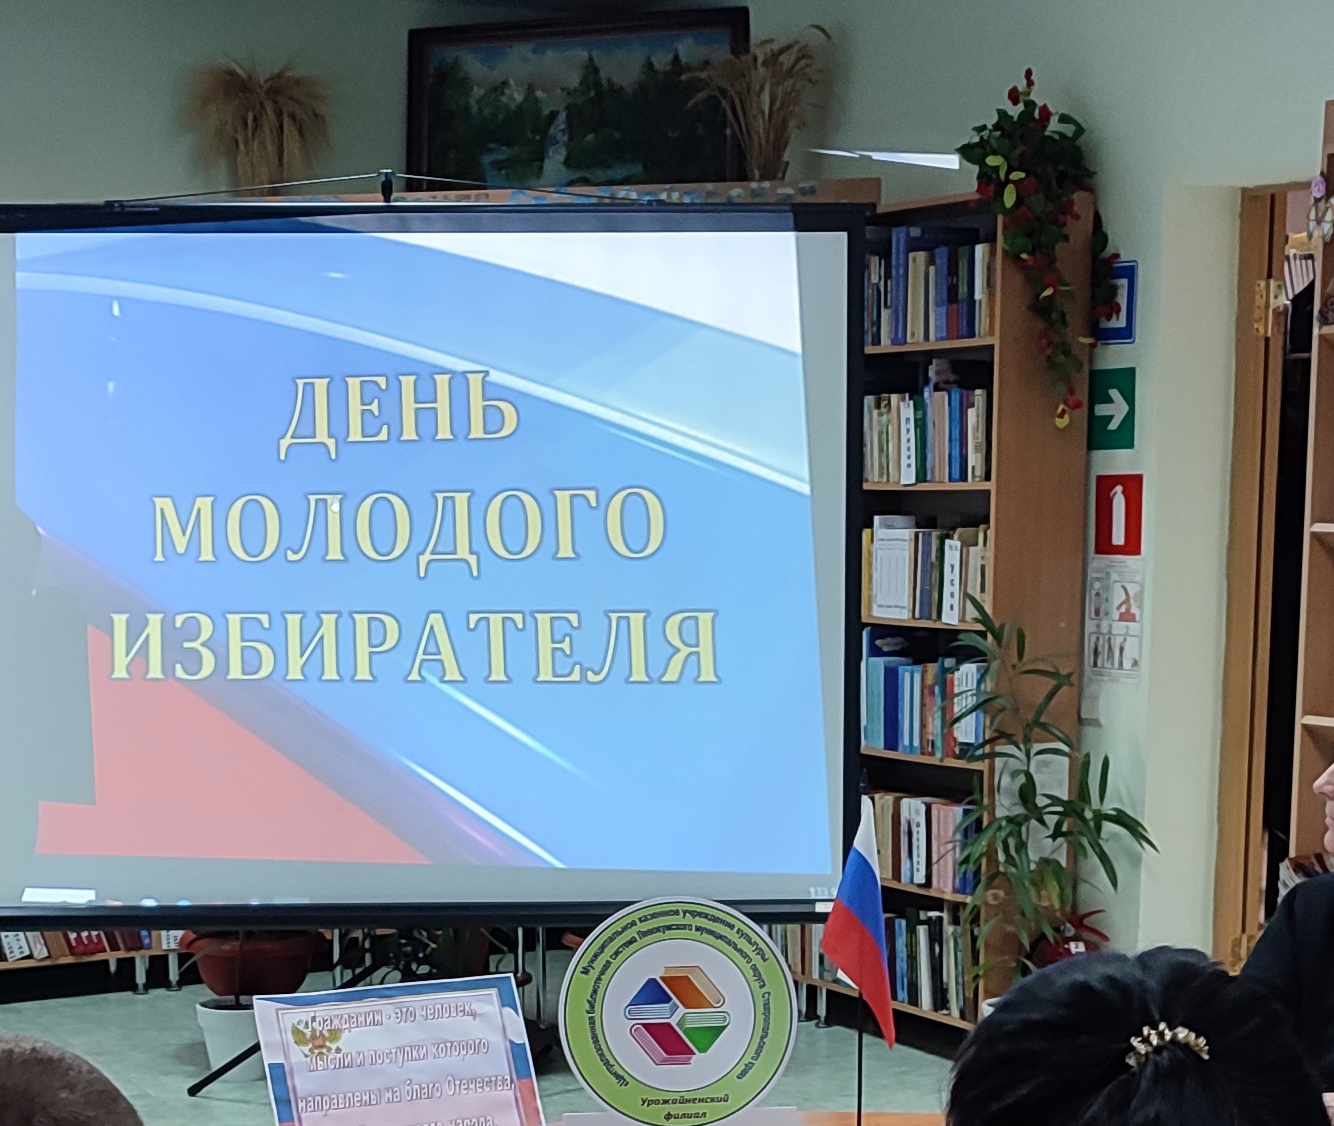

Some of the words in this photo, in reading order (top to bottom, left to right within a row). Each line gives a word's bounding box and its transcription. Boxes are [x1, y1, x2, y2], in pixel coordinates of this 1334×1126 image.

[279, 370, 519, 461] ДЕНЬ
[152, 487, 665, 579] МОЛОДОГО
[109, 610, 720, 684] ИЗБИРАТЕЛЯ
[307, 1008, 383, 1032] Гражданин
[394, 1009, 415, 1025] это
[420, 1000, 477, 1021] человек,
[307, 1052, 352, 1072] мысли
[356, 1052, 365, 1067] и
[368, 1045, 427, 1068] поступки
[432, 1038, 488, 1058] которого
[298, 1087, 381, 1116] направлены
[385, 1087, 401, 1103] на
[405, 1080, 442, 1101] благо
[446, 1074, 515, 1097] Отечества,
[640, 1094, 730, 1107] Урожайненский
[663, 1111, 707, 1122] филиал
